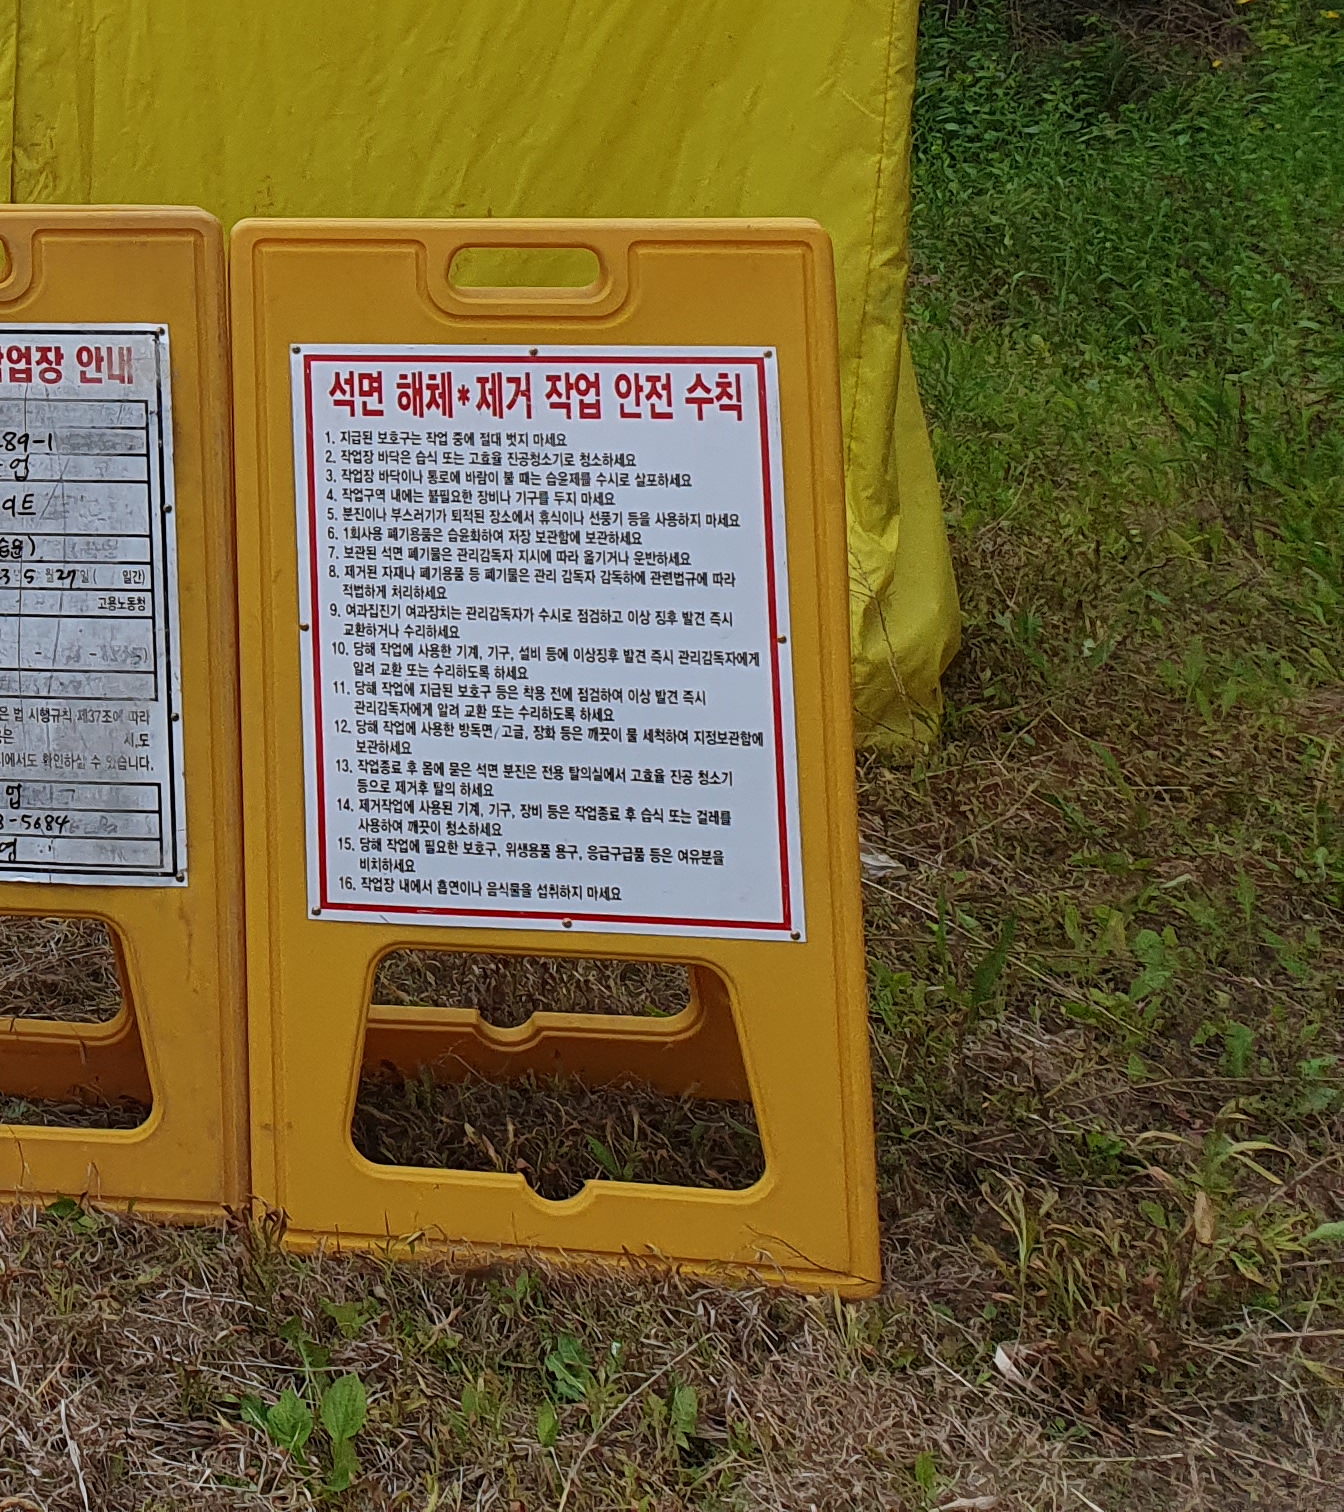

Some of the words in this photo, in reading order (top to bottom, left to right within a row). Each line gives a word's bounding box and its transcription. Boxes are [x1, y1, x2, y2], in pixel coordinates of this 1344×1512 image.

[328, 370, 384, 417] 석면
[545, 372, 601, 419] 작업
[614, 372, 673, 419] 안전
[684, 372, 742, 421] 수칙
[325, 430, 335, 444] 1.
[340, 430, 372, 445] 지급된
[377, 430, 422, 445] 보호구는
[425, 431, 447, 446] 작업
[452, 431, 474, 446] 중에
[479, 431, 501, 446] 절대
[505, 431, 528, 447] 벗지
[532, 432, 567, 447] 마세요
[96, 595, 147, 612] 고용노동청
[338, 876, 356, 890] 16.
[360, 876, 395, 892] 작업장
[398, 878, 432, 894] 내에서
[436, 879, 482, 896] 흡연이나
[486, 881, 532, 898] 음식물을
[536, 883, 582, 900] 섭취하지
[586, 885, 622, 901] 마세요
